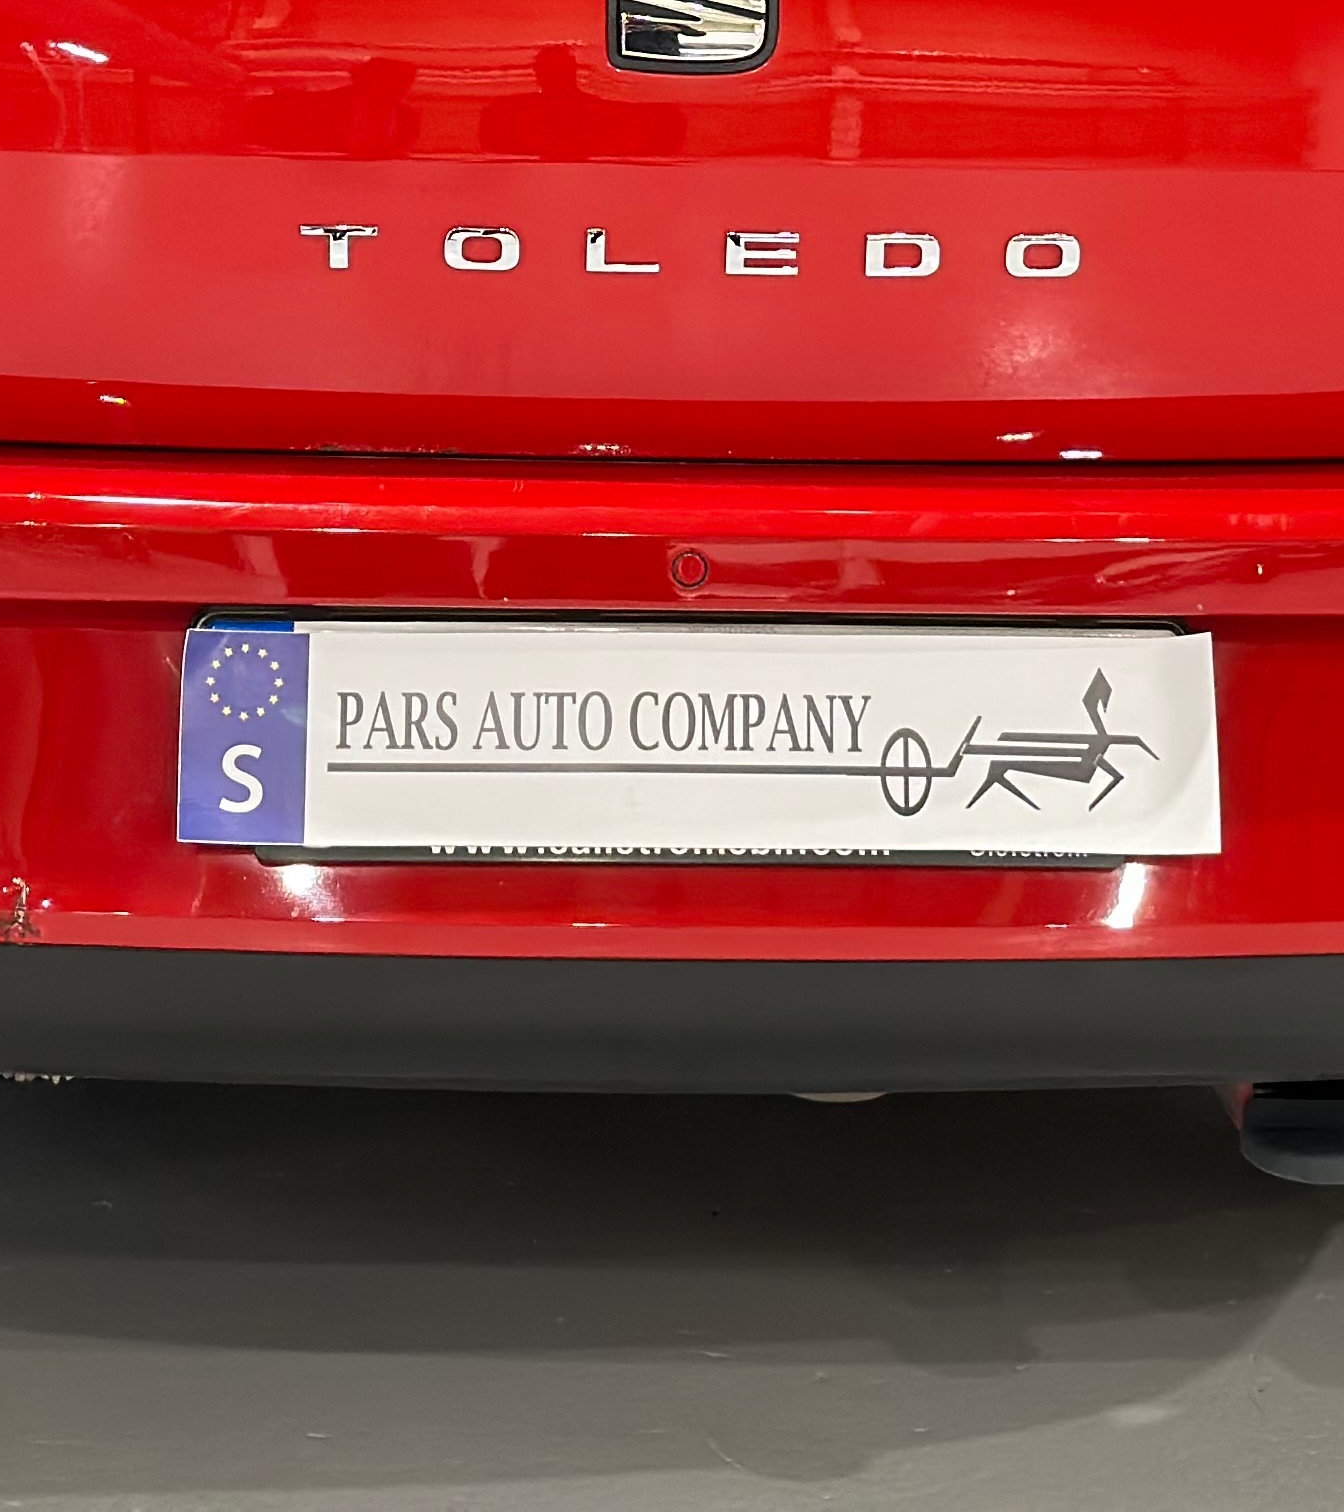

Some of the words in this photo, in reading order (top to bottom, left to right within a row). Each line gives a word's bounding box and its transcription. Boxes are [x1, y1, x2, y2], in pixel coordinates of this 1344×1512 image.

[299, 223, 1081, 278] TOLEDO
[335, 690, 458, 751] PARS
[471, 690, 614, 751] AUTO
[628, 691, 872, 754] COMPANY
[218, 743, 264, 814] S
